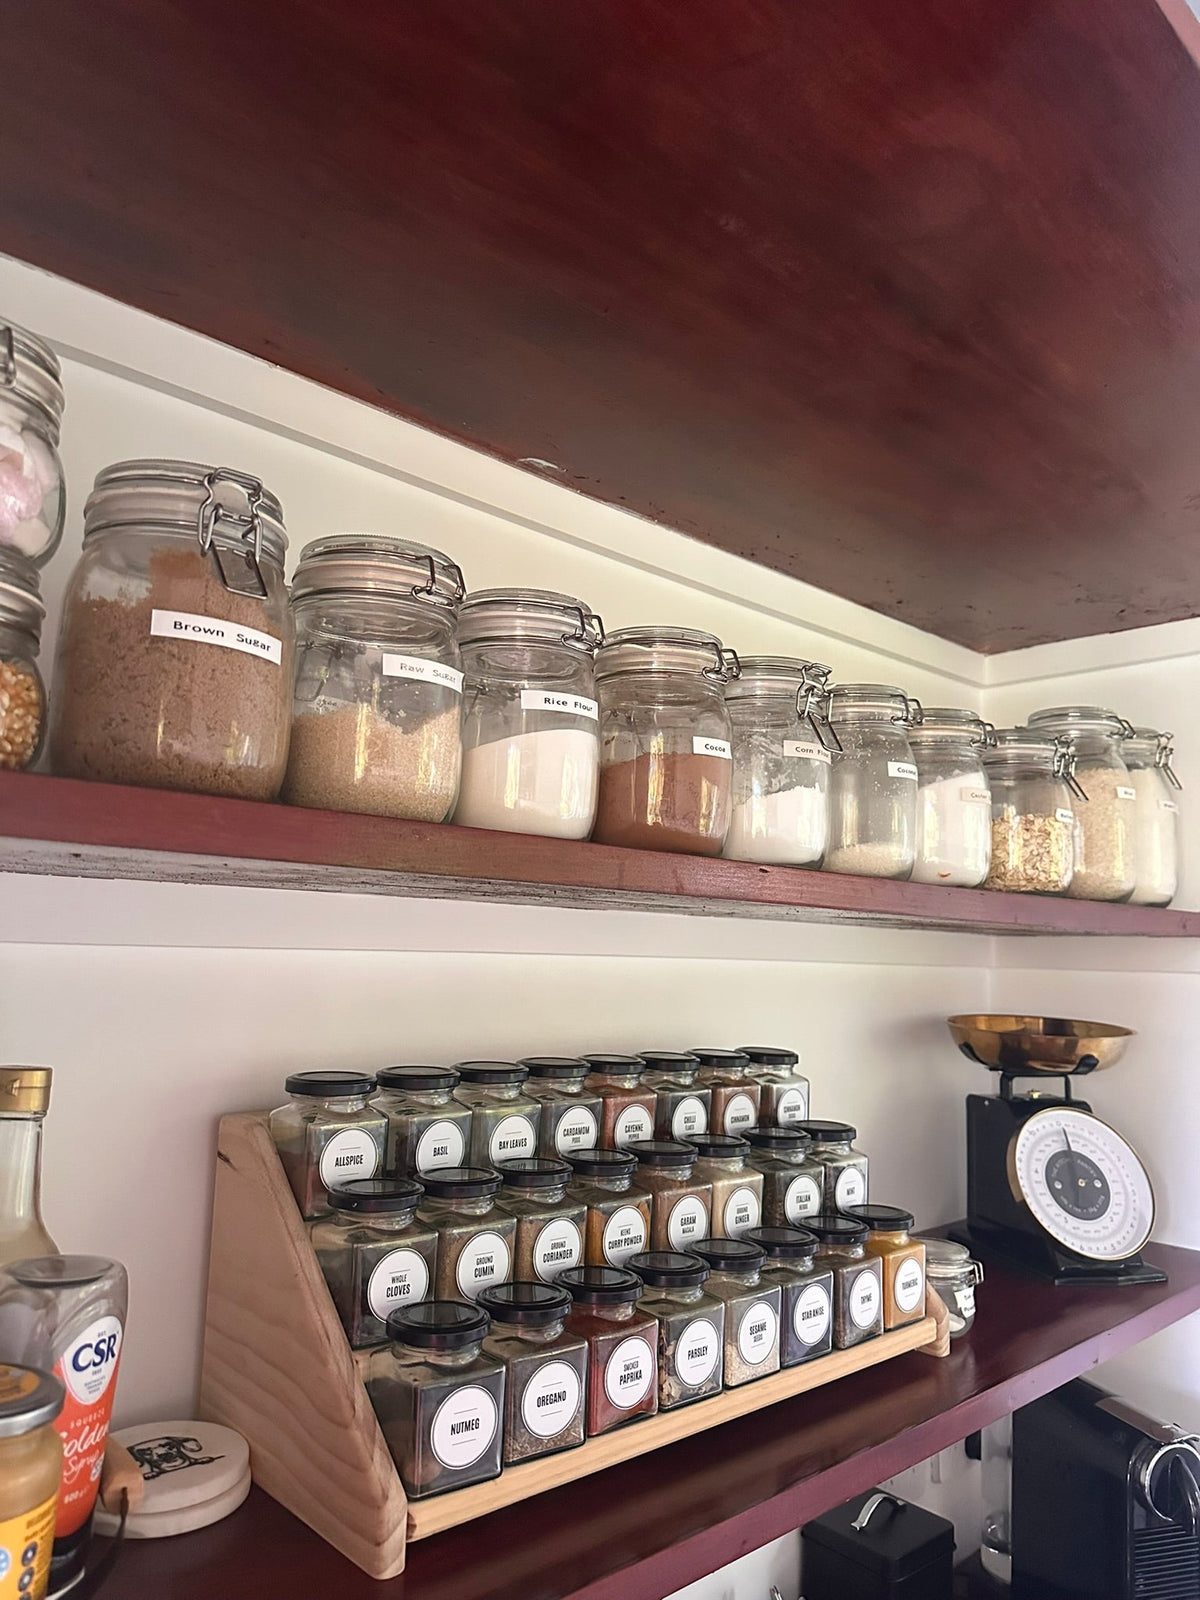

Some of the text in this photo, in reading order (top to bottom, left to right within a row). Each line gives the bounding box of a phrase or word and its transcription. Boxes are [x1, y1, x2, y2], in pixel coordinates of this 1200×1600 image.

[173, 620, 271, 652] Brown Sugar
[400, 662, 425, 674] Raw
[543, 697, 568, 707] Rice
[704, 743, 726, 753] Cocoa
[795, 746, 814, 754] Corn
[562, 1126, 591, 1138] CARDAMOM
[624, 1123, 645, 1134] CAYENNE
[498, 1137, 528, 1151] BAY LEAVES
[432, 1145, 449, 1158] BASIL
[334, 1154, 364, 1168] ALLSPICE
[680, 1215, 697, 1227] GARAM
[734, 1213, 750, 1225] GINGER
[550, 1240, 567, 1251] GROUND
[608, 1234, 643, 1250] CURRY POWDER
[476, 1255, 493, 1266] GROUND
[543, 1248, 573, 1264] CORIANDER
[474, 1264, 494, 1278] CUMIN
[391, 1273, 408, 1284] WHOLE
[386, 1283, 411, 1298] CLOVES
[860, 1293, 873, 1305] THYME
[801, 1305, 825, 1321] STAR ANISE
[749, 1321, 767, 1336] SESAME
[72, 1333, 117, 1373] CSR
[687, 1345, 708, 1361] PARSLEY
[623, 1360, 639, 1372] SMOKED
[619, 1369, 643, 1386] PAPRIKA
[536, 1390, 567, 1408] OREGANO
[70, 1407, 105, 1430] SQUEEZE
[450, 1418, 480, 1436] NUTMEG
